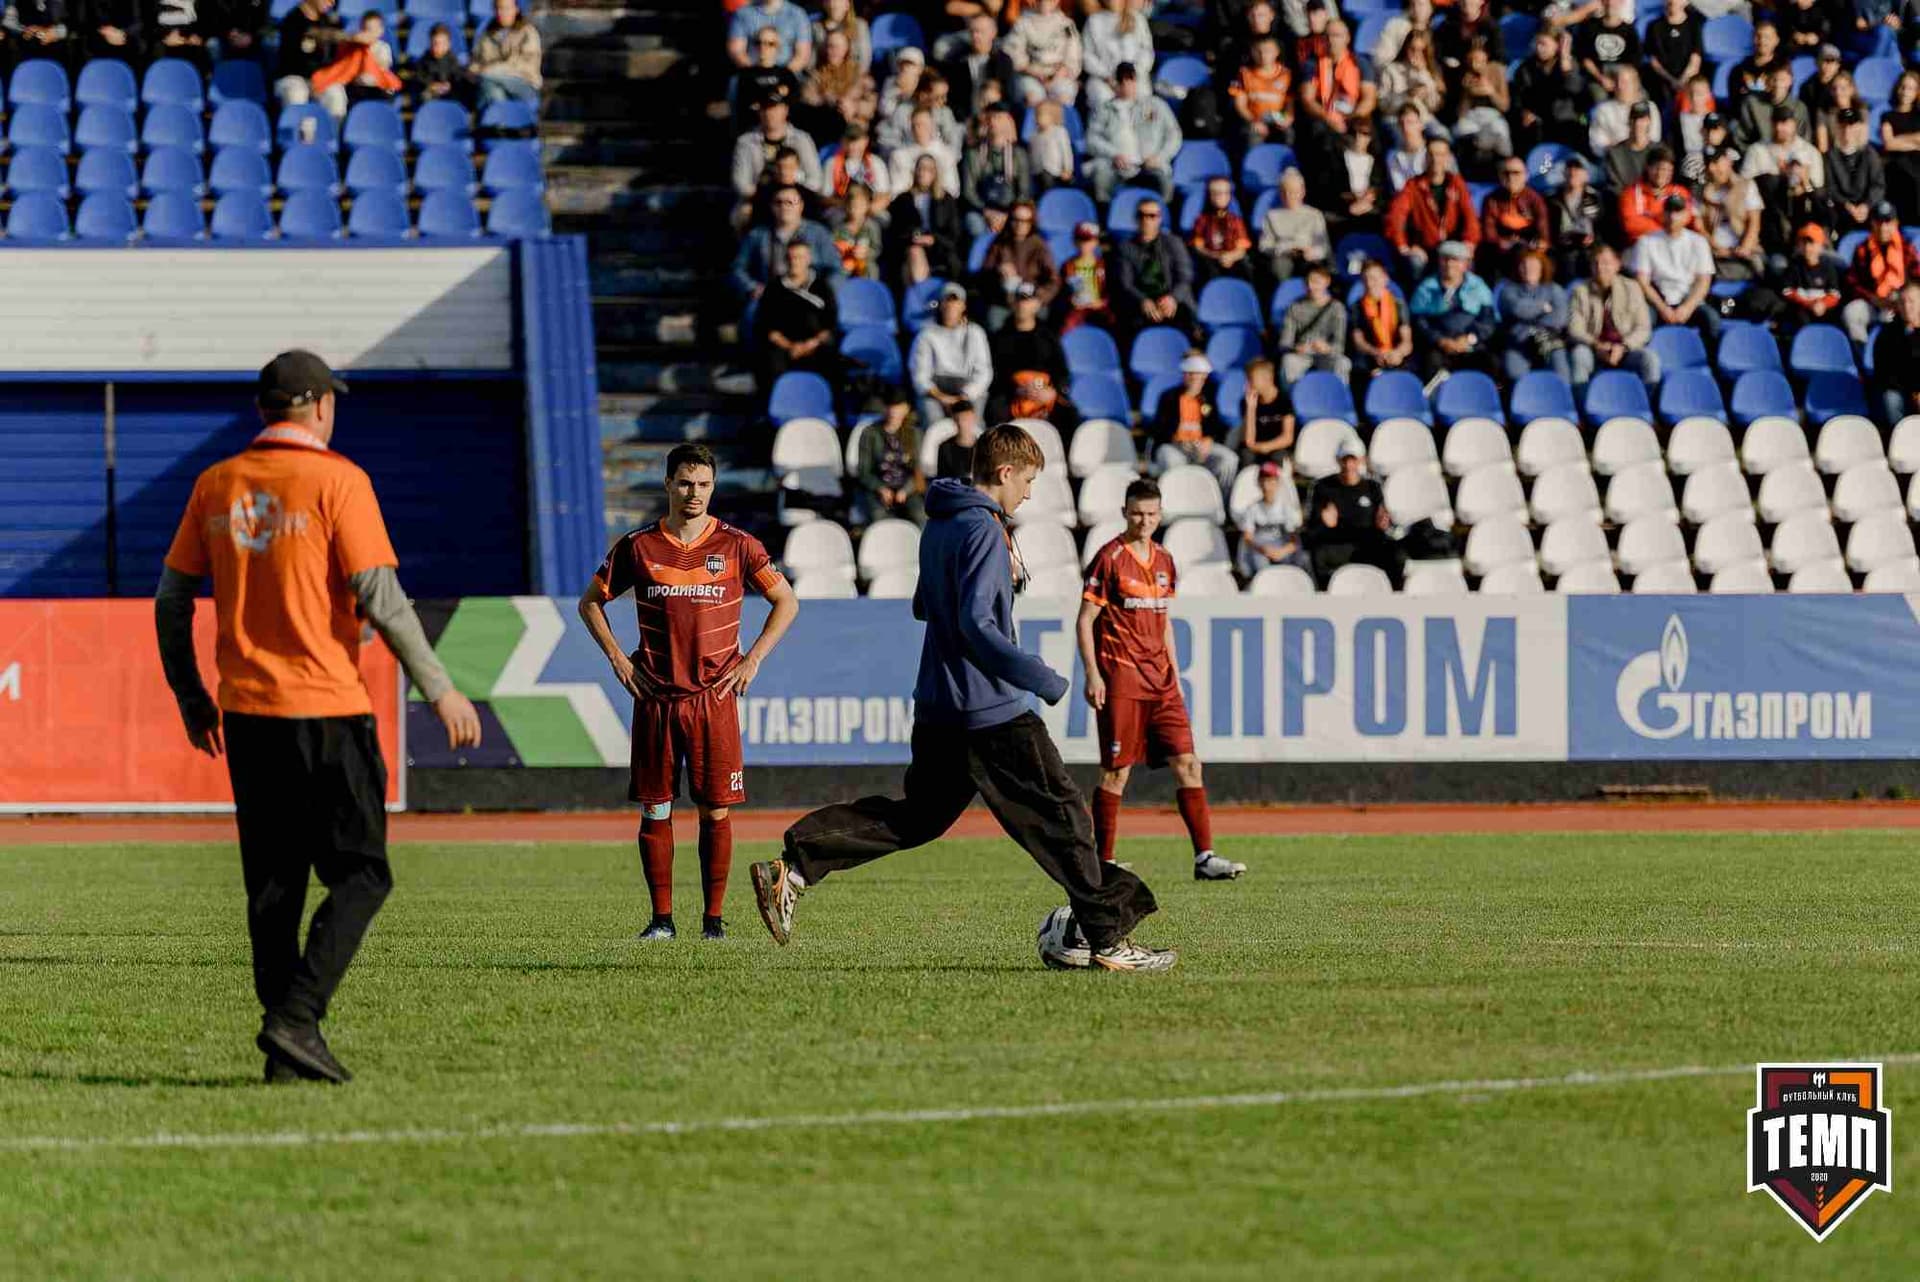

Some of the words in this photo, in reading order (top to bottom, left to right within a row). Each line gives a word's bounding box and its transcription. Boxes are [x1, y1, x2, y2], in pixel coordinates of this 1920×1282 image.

[647, 584, 727, 599] ПРОДИНВЕСТ
[1693, 691, 1872, 740] ГАЗПРОМ
[730, 770, 744, 791] 23
